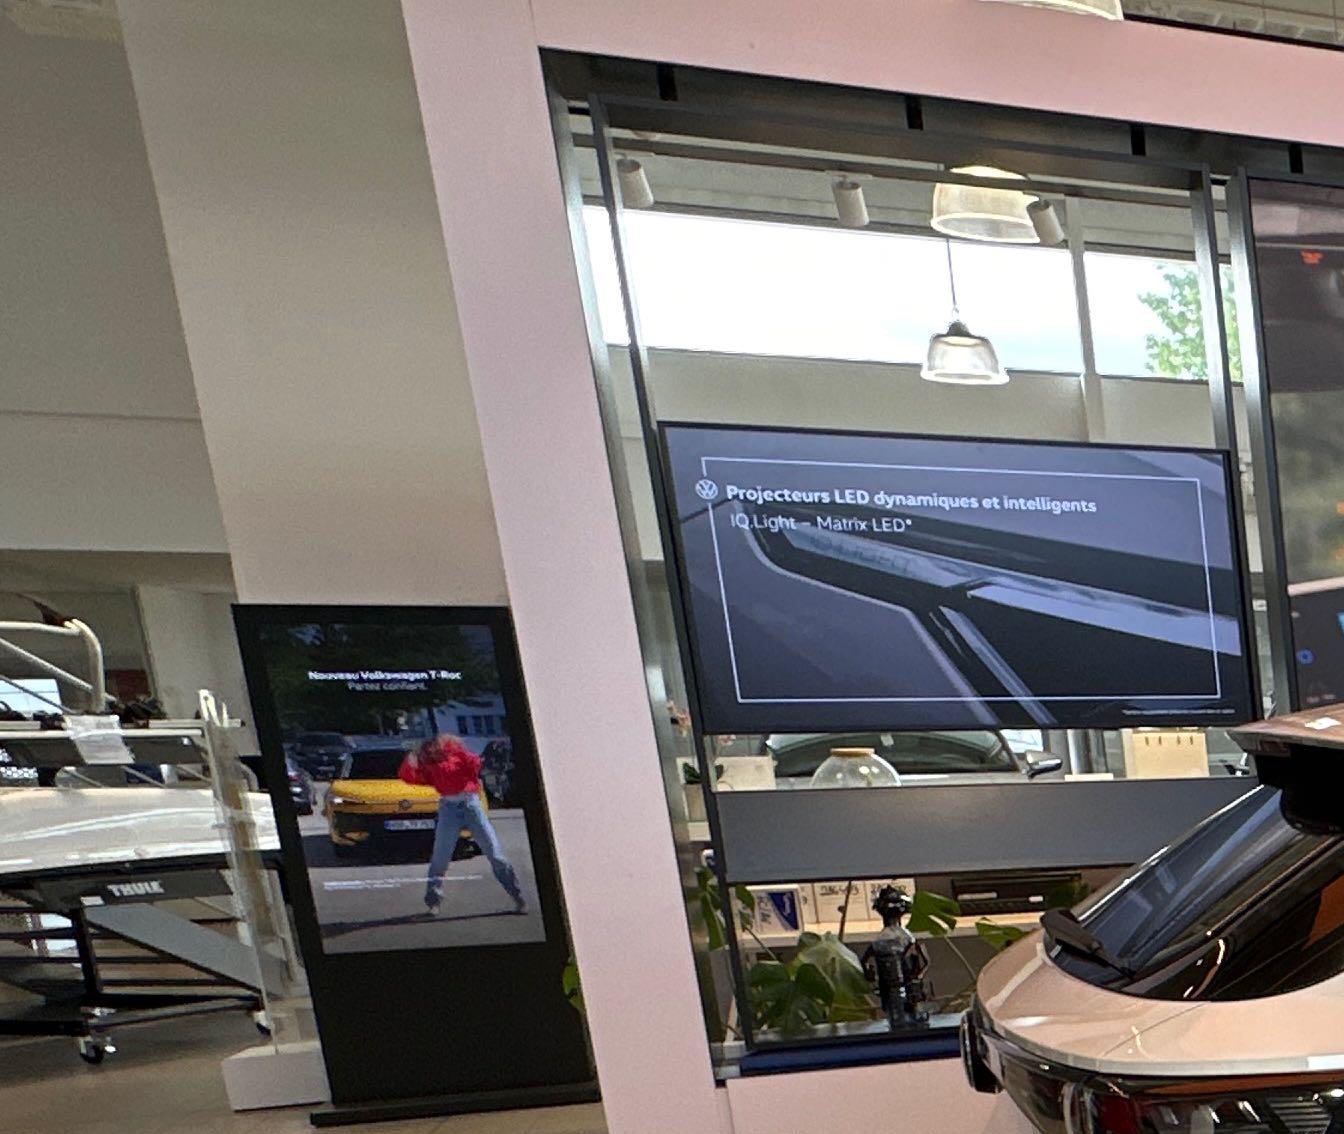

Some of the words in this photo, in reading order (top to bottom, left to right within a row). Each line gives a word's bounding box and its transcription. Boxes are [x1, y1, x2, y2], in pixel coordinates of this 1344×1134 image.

[726, 484, 830, 505] Projecteurs
[834, 488, 870, 505] LED
[874, 490, 979, 511] dynamiques
[983, 496, 1000, 509] et
[1003, 495, 1097, 514] intelligents
[730, 512, 797, 533] IQ.Light
[816, 515, 868, 532] Matrix
[107, 880, 165, 897] THULE
